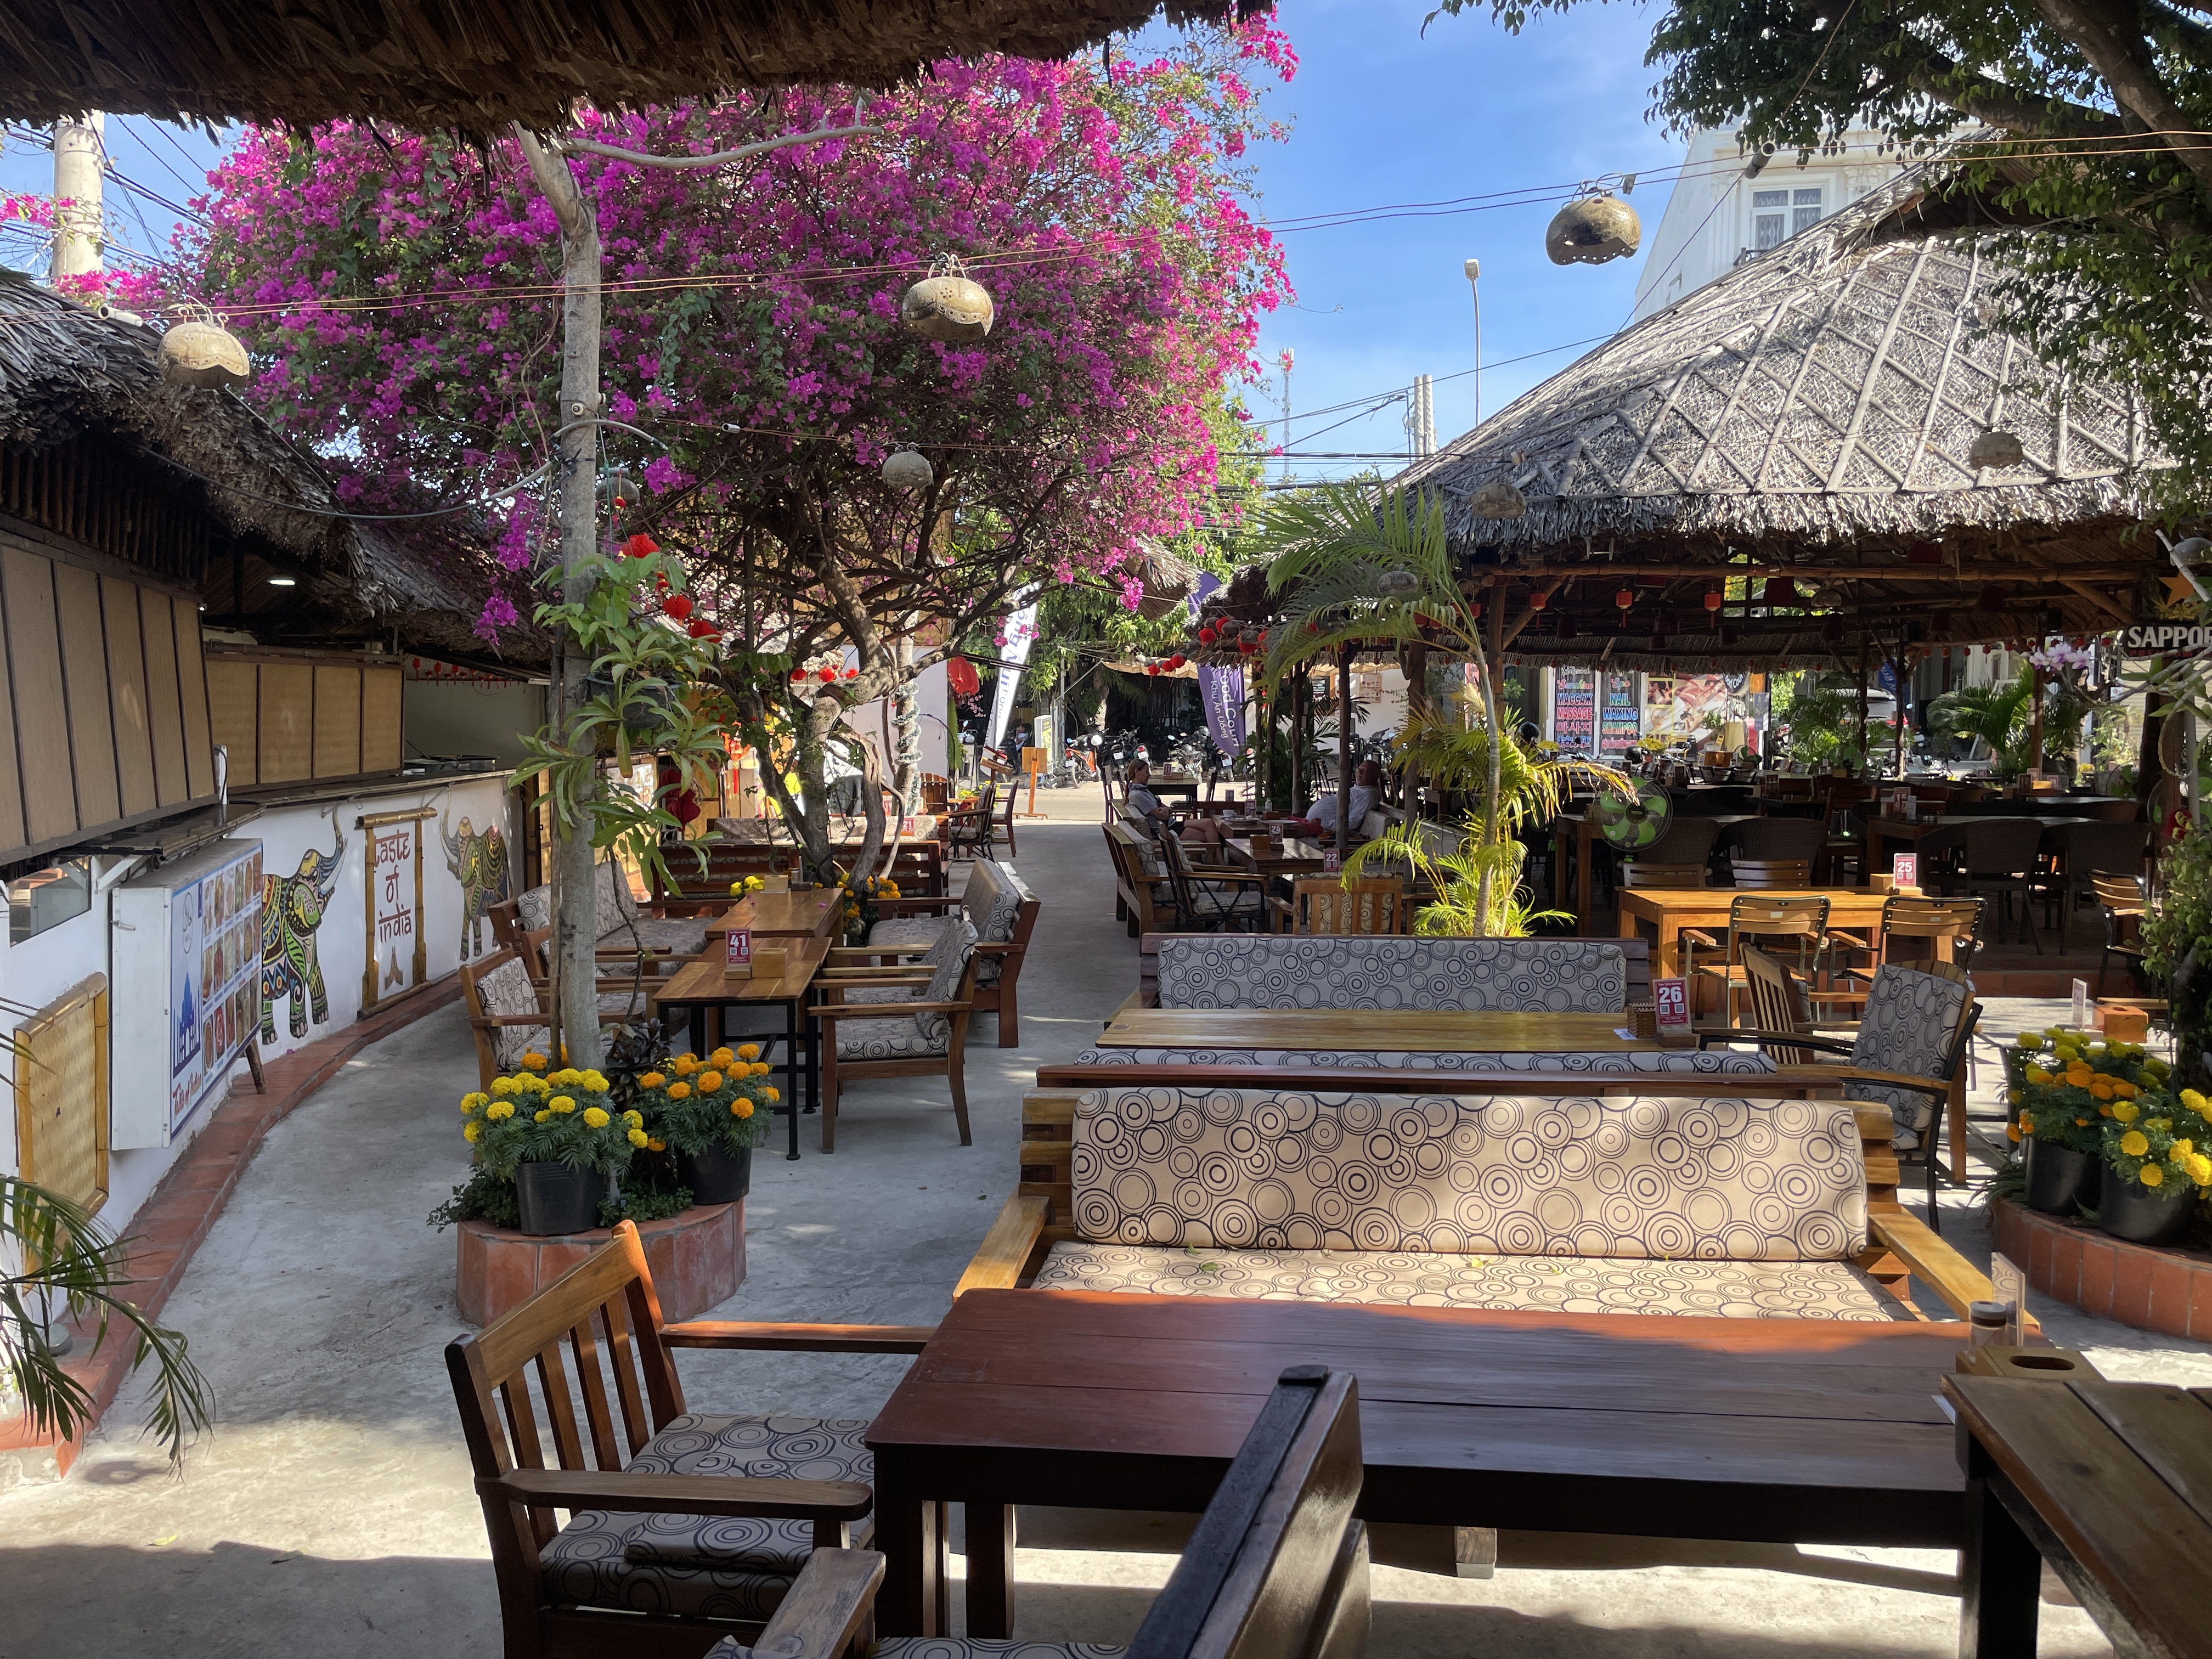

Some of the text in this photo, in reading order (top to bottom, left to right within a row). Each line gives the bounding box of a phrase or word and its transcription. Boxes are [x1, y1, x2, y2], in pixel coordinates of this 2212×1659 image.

[1210, 680, 1218, 699] Khu
[1220, 670, 1235, 703] ood
[1610, 677, 1630, 691] Spa
[1557, 693, 1593, 706] МАССАЖ
[1610, 693, 1630, 706] NAIL
[1213, 701, 1223, 714] Ăn
[1557, 707, 1592, 720] MASSAGE
[1602, 707, 1638, 721] WAXING
[1225, 707, 1239, 747] Court
[1556, 721, 1592, 735] 마사지
[1602, 722, 1638, 735] SHAMPOO
[1271, 825, 1281, 834] 24
[374, 830, 410, 868] taste
[1325, 853, 1338, 862] 22
[1897, 861, 1913, 872] 25
[386, 864, 399, 903] of
[379, 902, 412, 944] india
[730, 934, 746, 947] 41
[1658, 986, 1683, 1003] 26
